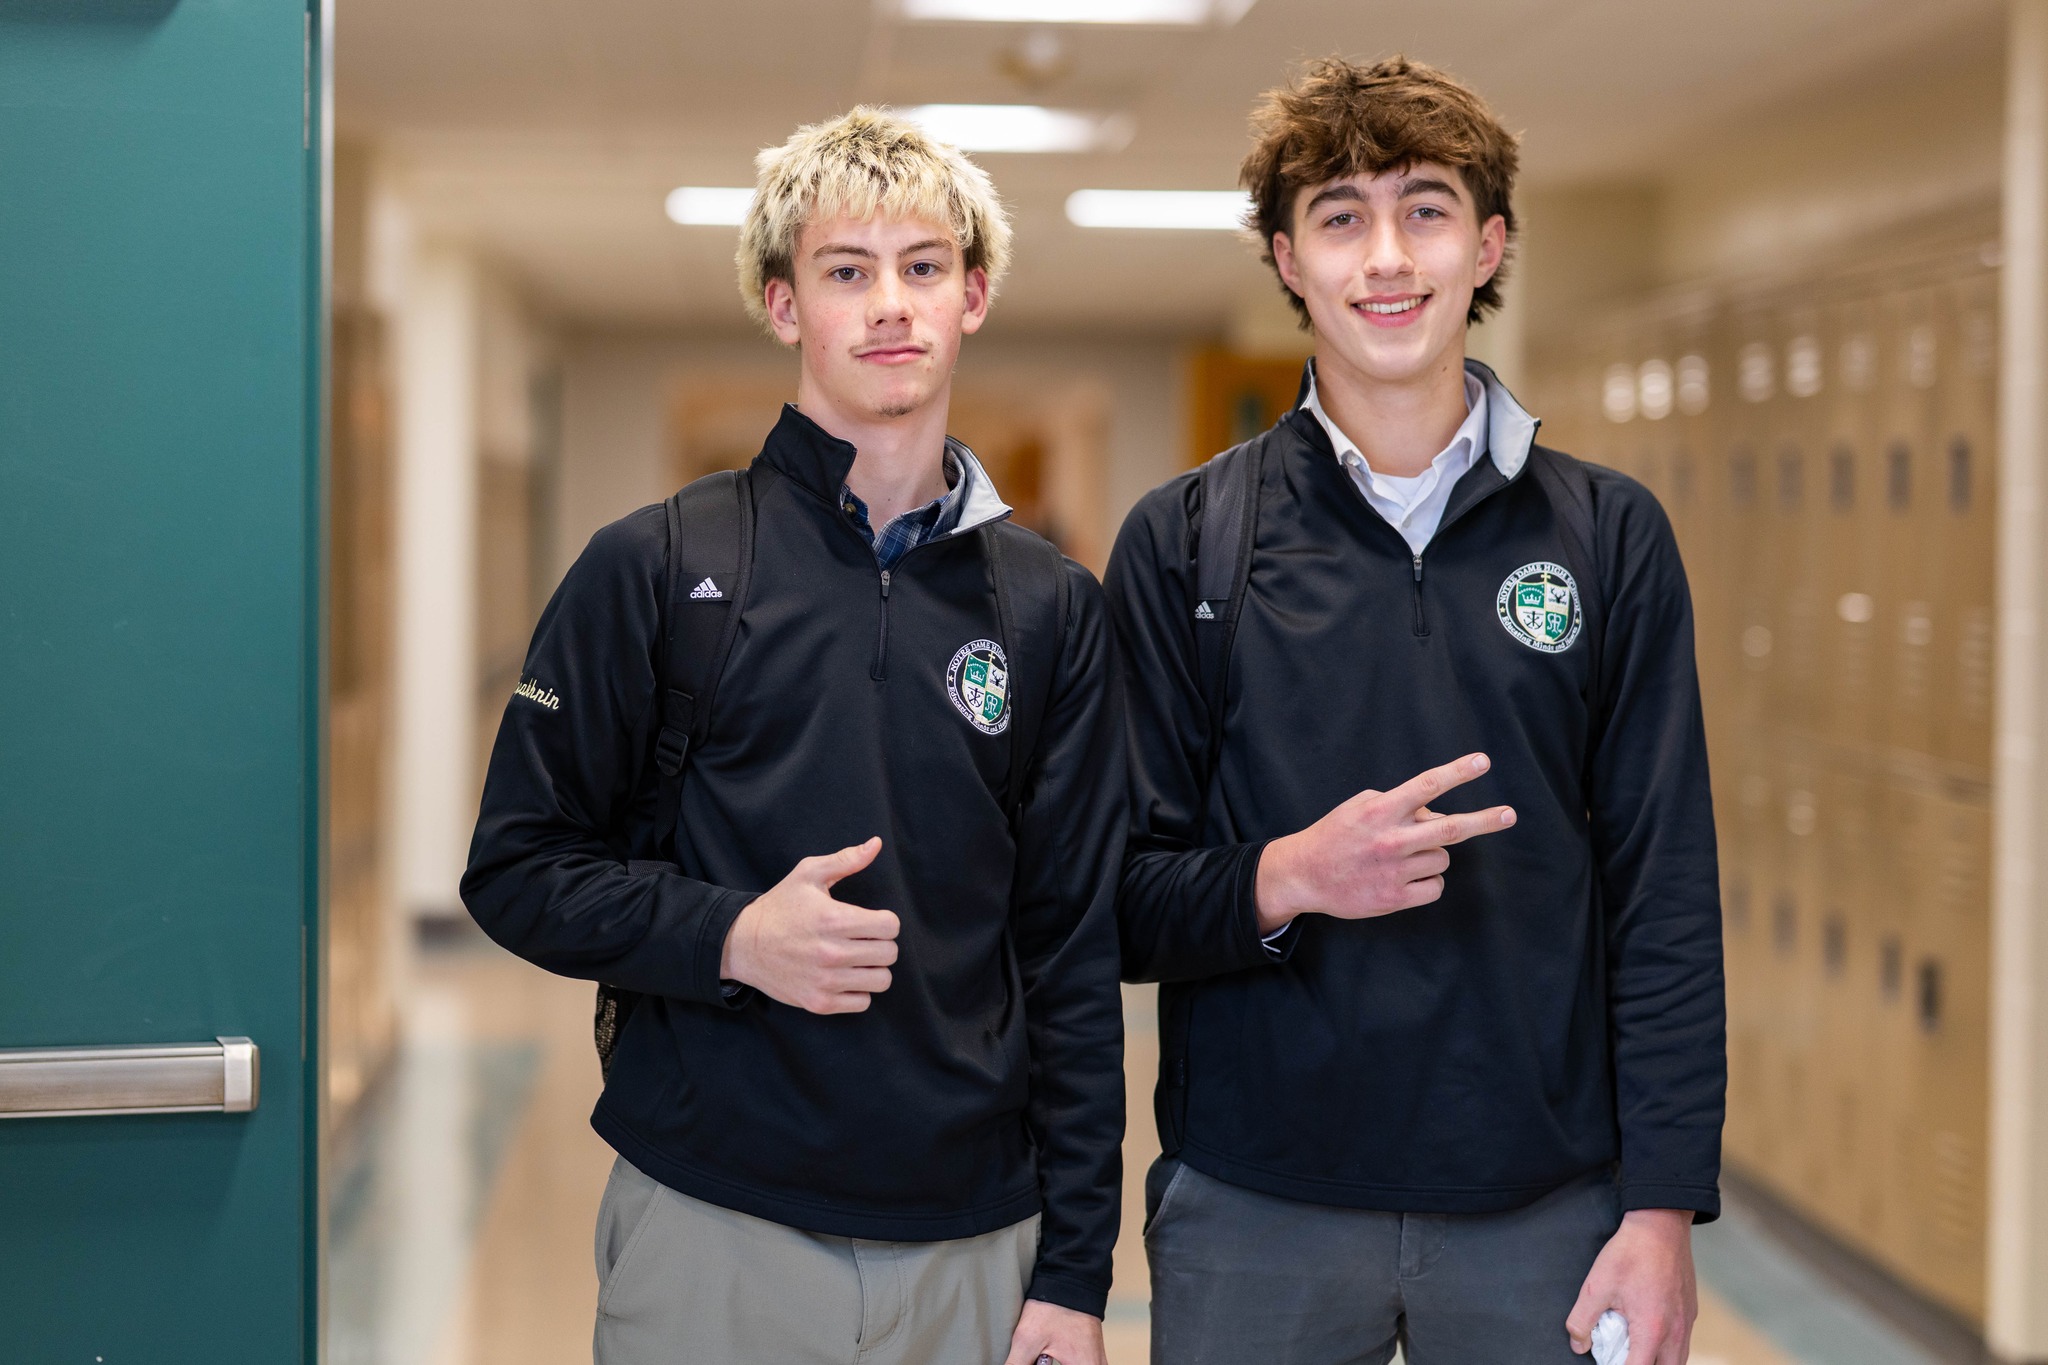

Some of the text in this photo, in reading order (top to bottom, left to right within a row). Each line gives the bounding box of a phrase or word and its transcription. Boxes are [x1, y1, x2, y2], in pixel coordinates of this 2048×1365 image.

[690, 590, 722, 598] adidas
[1499, 575, 1518, 603] NOTRE
[1517, 564, 1542, 578] DAME
[1544, 564, 1567, 577] HIGH
[1502, 616, 1533, 645] Educating
[1532, 640, 1554, 651] Minds
[1554, 642, 1566, 651] and
[950, 646, 971, 673] NOTRE
[971, 641, 991, 651] DAME
[949, 686, 973, 721] Educating
[972, 718, 990, 732] Minds
